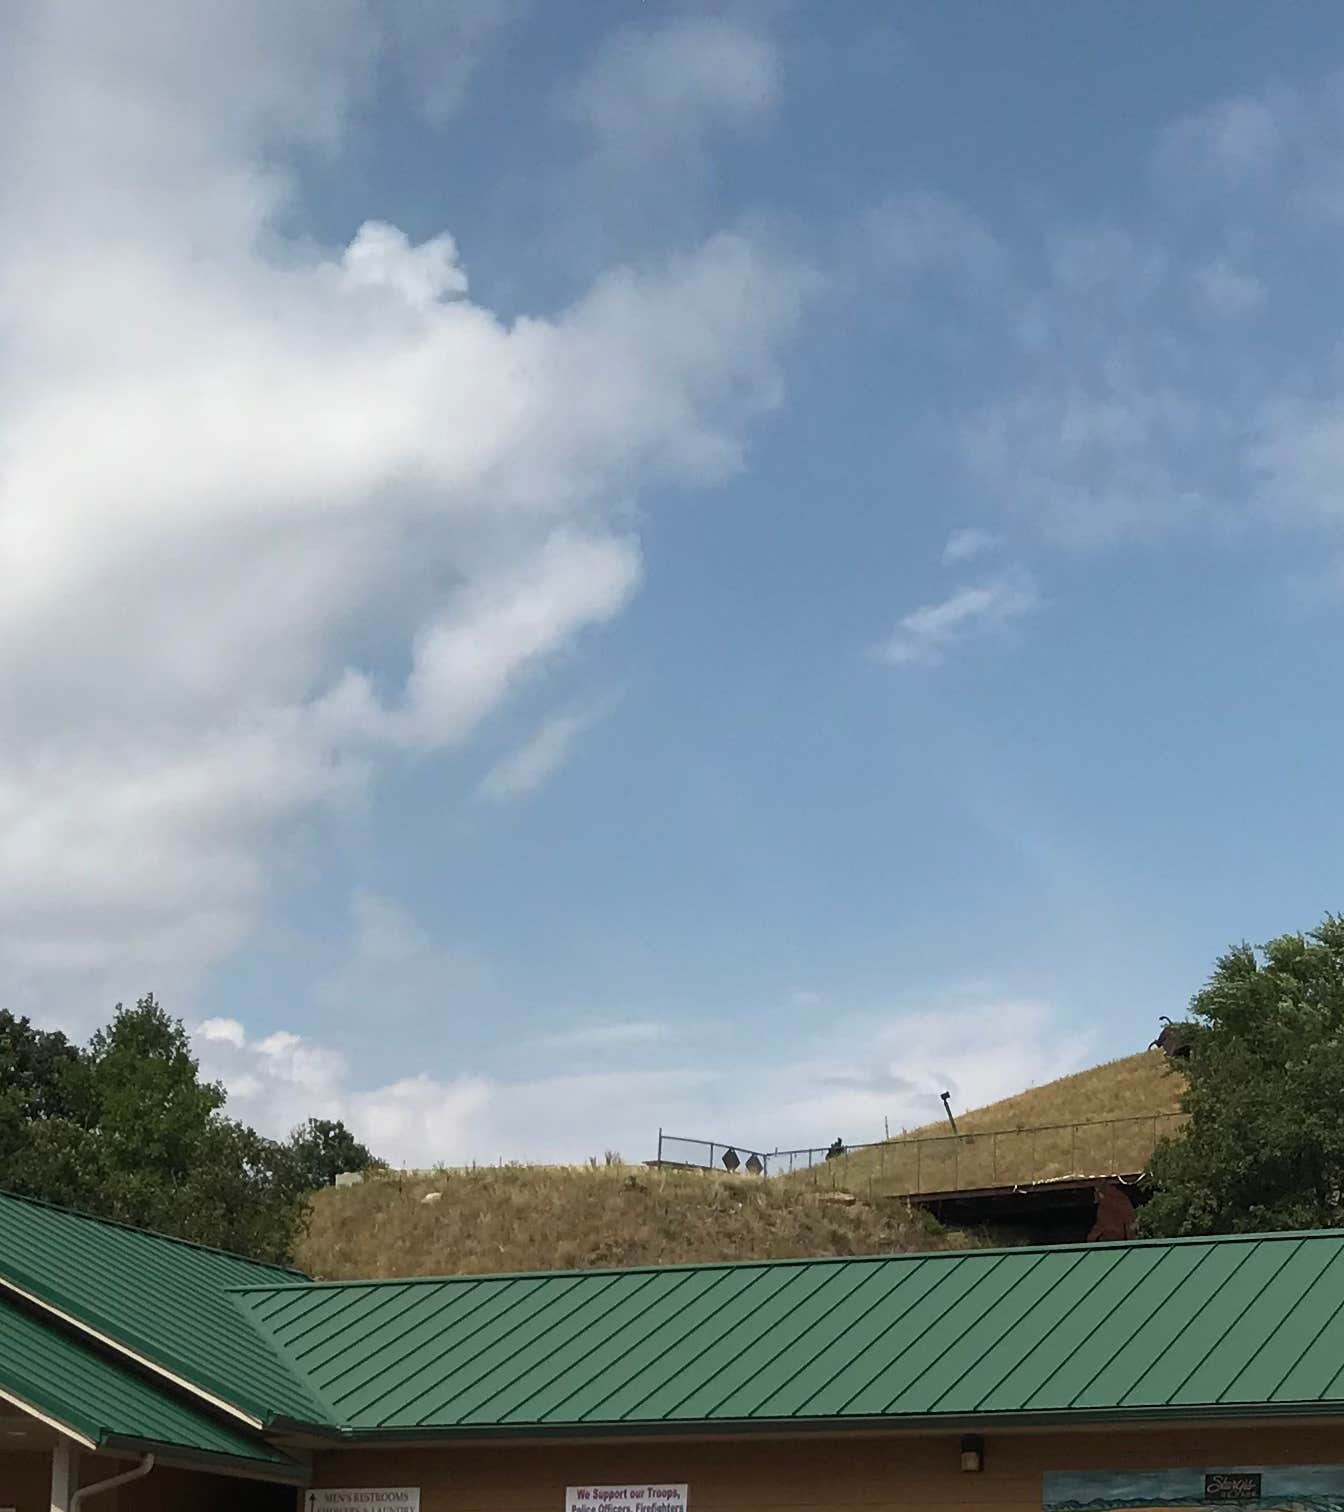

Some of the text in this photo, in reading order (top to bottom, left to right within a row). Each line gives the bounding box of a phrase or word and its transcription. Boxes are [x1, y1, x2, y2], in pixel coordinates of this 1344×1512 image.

[353, 1492, 409, 1502] RESTROOMS
[576, 1487, 680, 1501] We Support our Troops,
